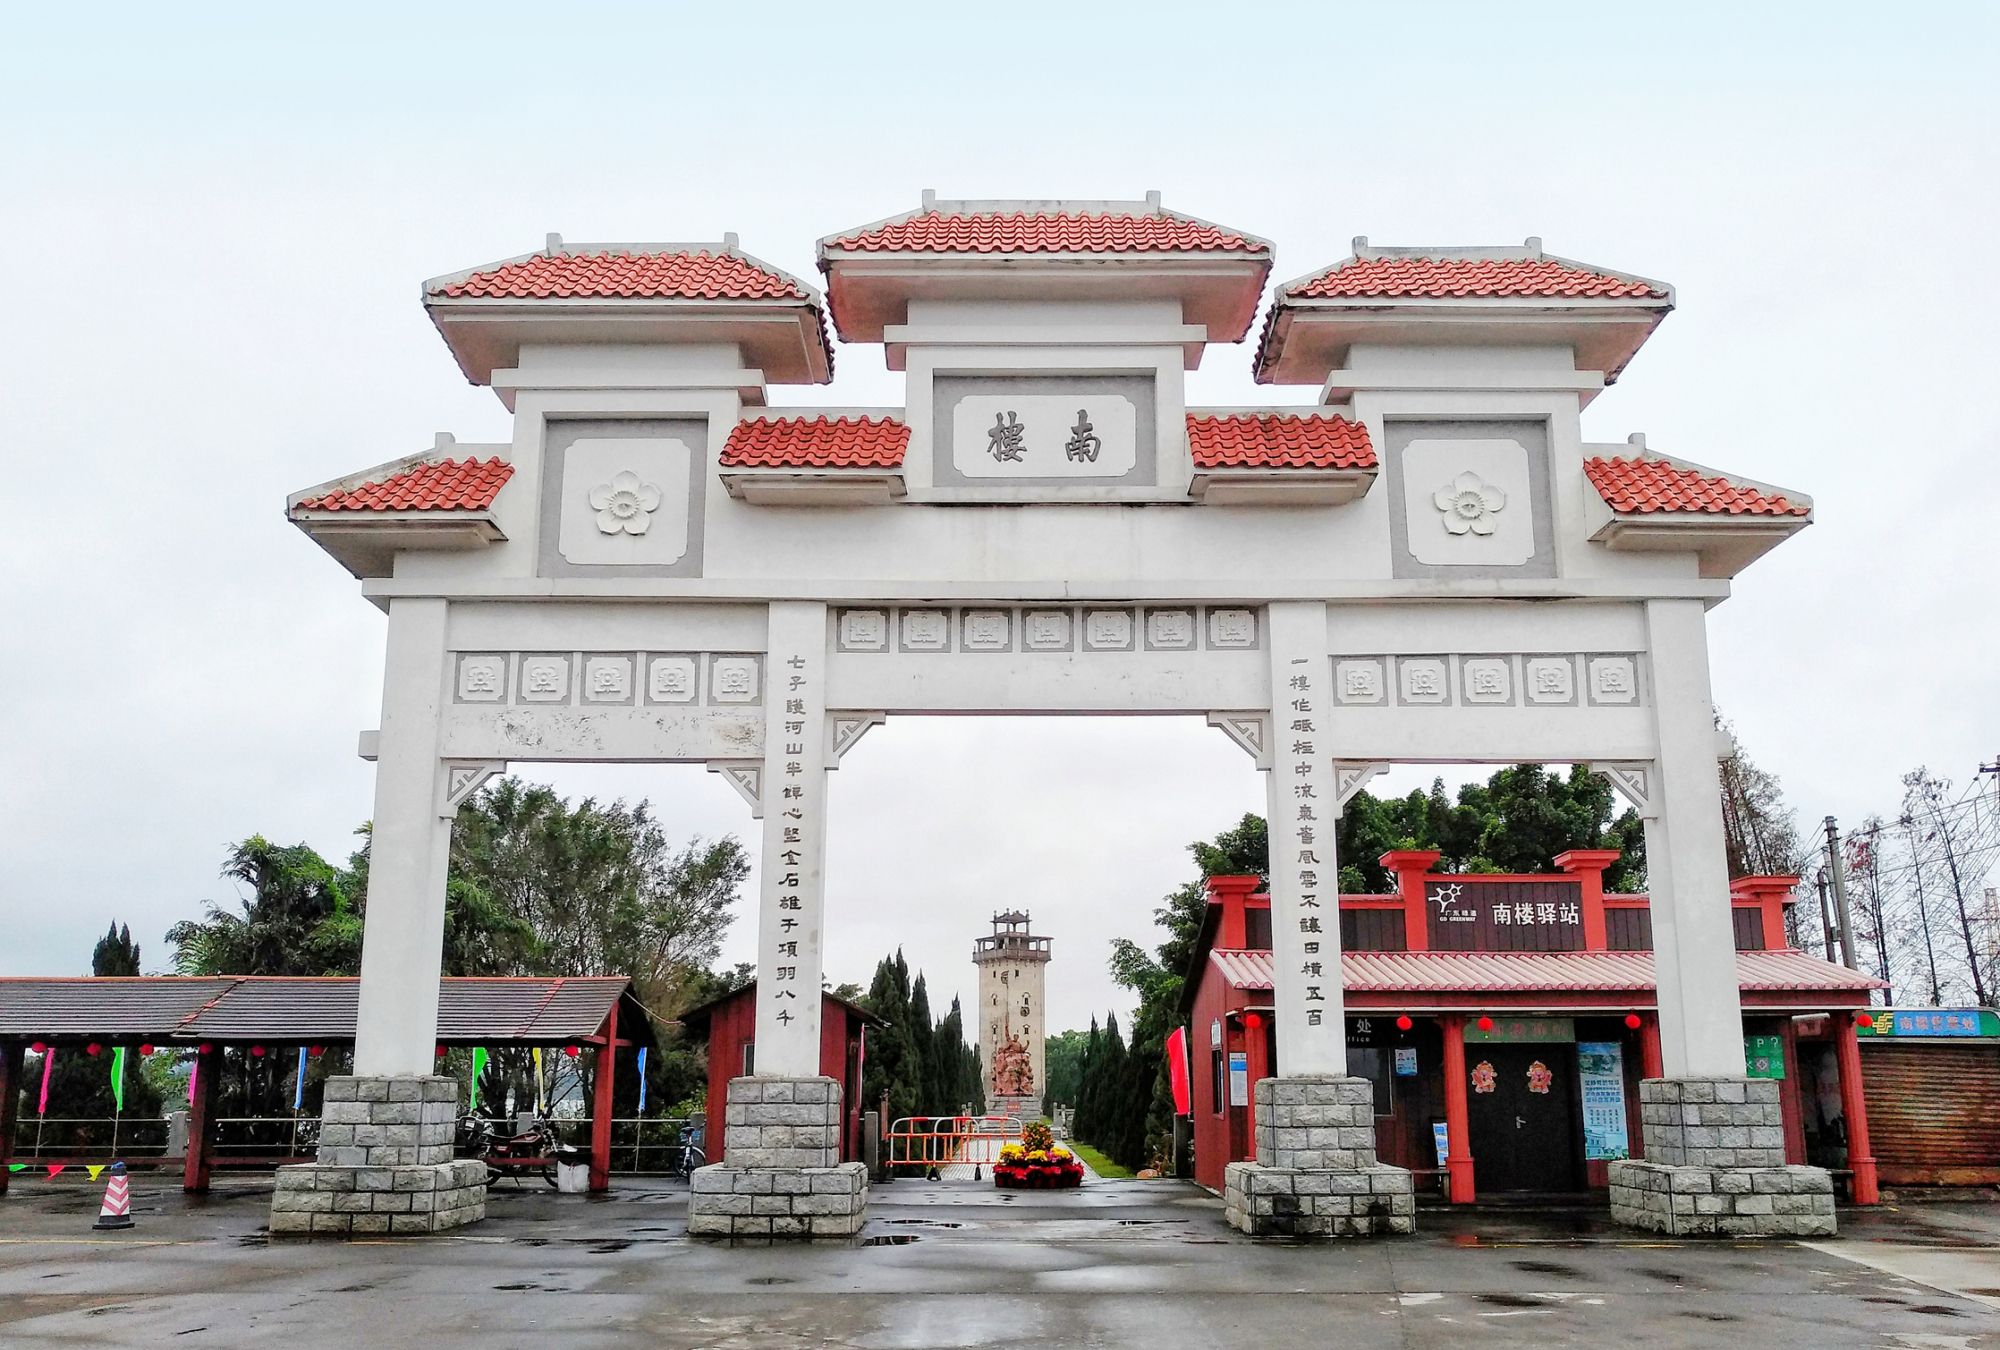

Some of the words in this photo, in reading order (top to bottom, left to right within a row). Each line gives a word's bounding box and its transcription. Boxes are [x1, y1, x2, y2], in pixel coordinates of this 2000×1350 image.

[1492, 902, 1579, 925] 南楼驿站
[1356, 1018, 1372, 1034] 处
